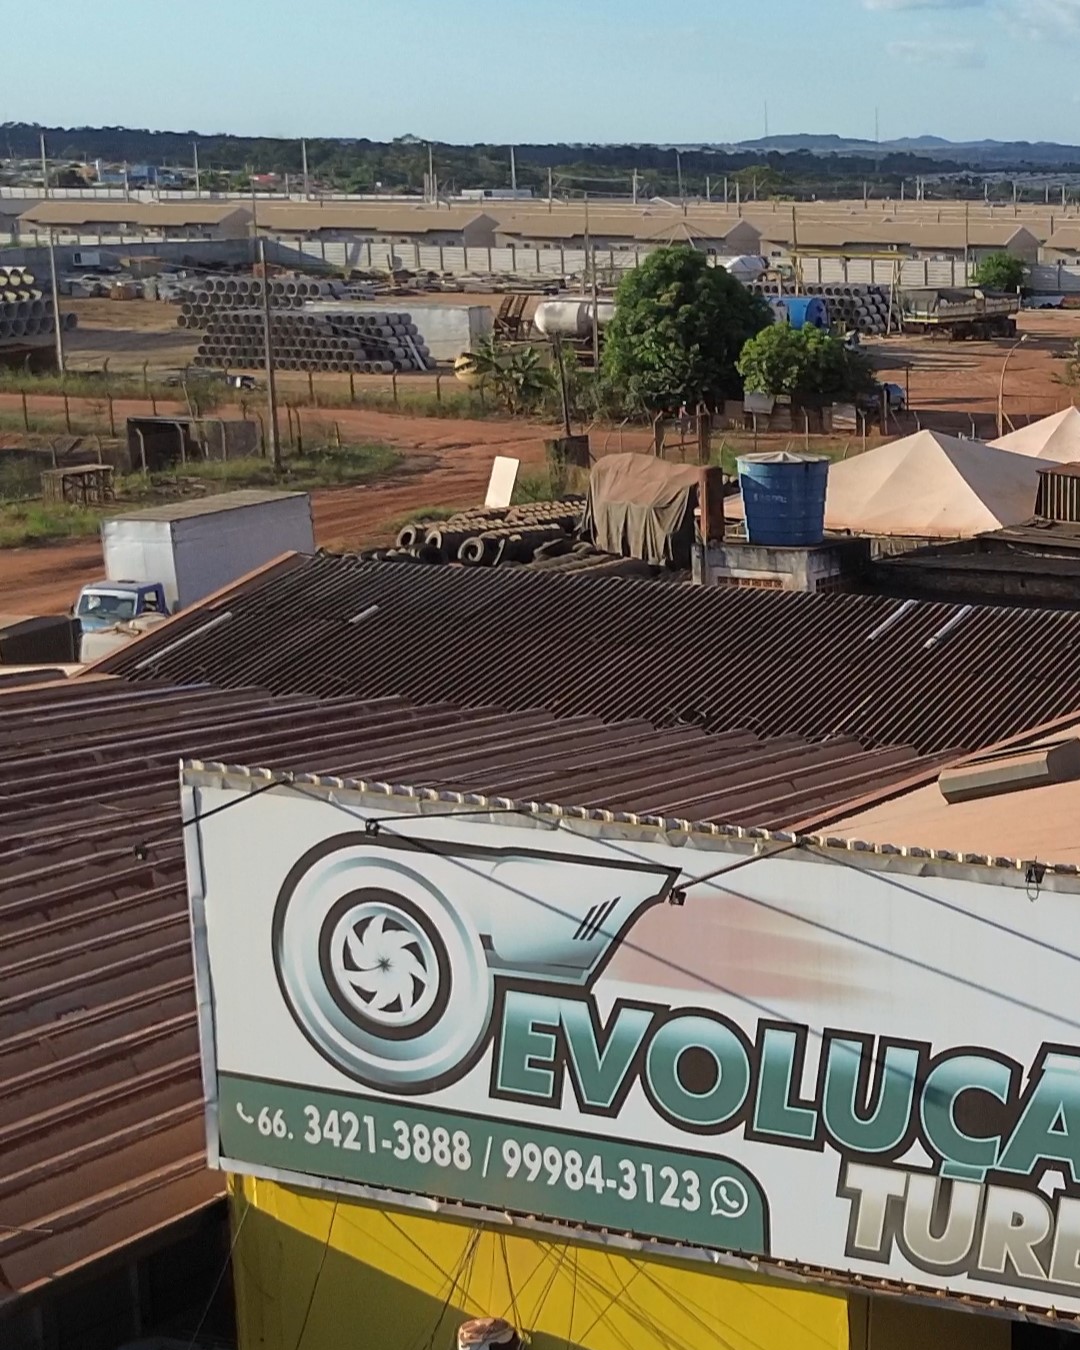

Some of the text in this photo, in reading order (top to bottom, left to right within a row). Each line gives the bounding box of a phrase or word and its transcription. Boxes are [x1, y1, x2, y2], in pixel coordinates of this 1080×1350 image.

[258, 1106, 294, 1140] 66.
[304, 1105, 472, 1171] 3421-3888
[502, 1139, 701, 1211] 99984-3123
